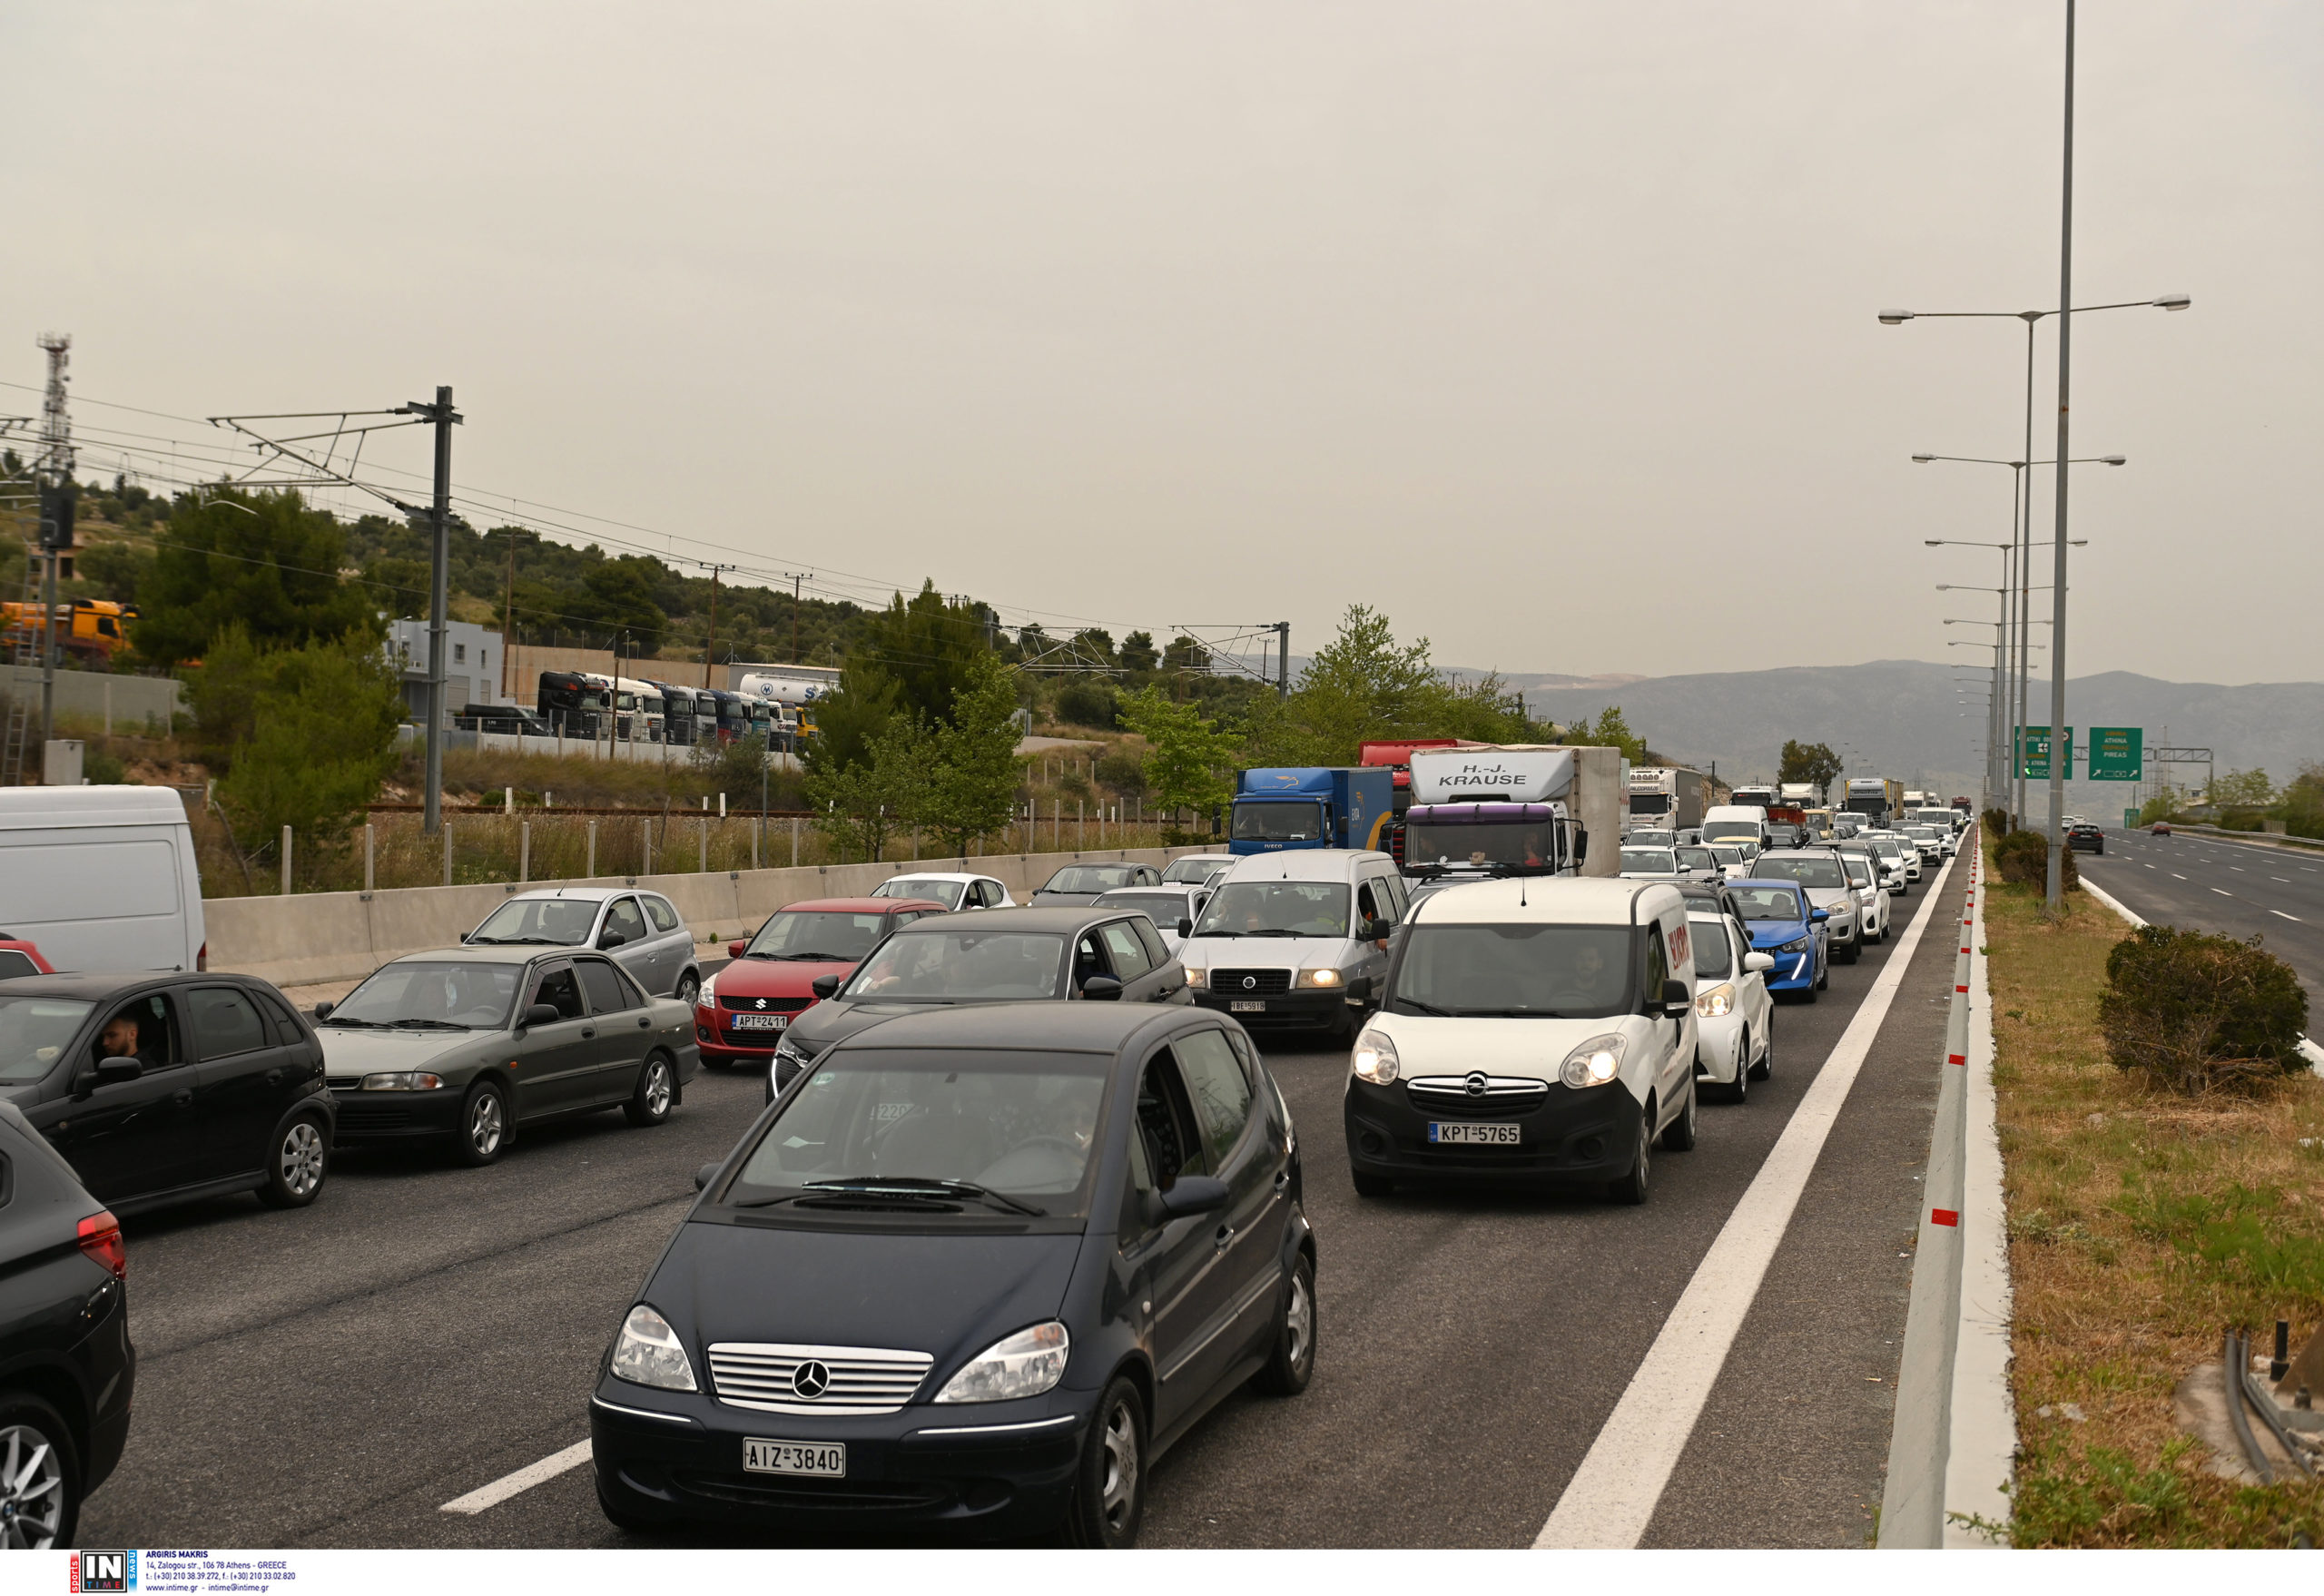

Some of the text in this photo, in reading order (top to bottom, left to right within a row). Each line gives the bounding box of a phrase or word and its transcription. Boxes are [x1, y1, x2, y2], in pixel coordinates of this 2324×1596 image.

[1462, 764, 1507, 773] H.-J.
[1439, 774, 1527, 786] KRAUSE
[1442, 1126, 1518, 1142] KPT-5765
[749, 1445, 840, 1470] AIZ-3840
